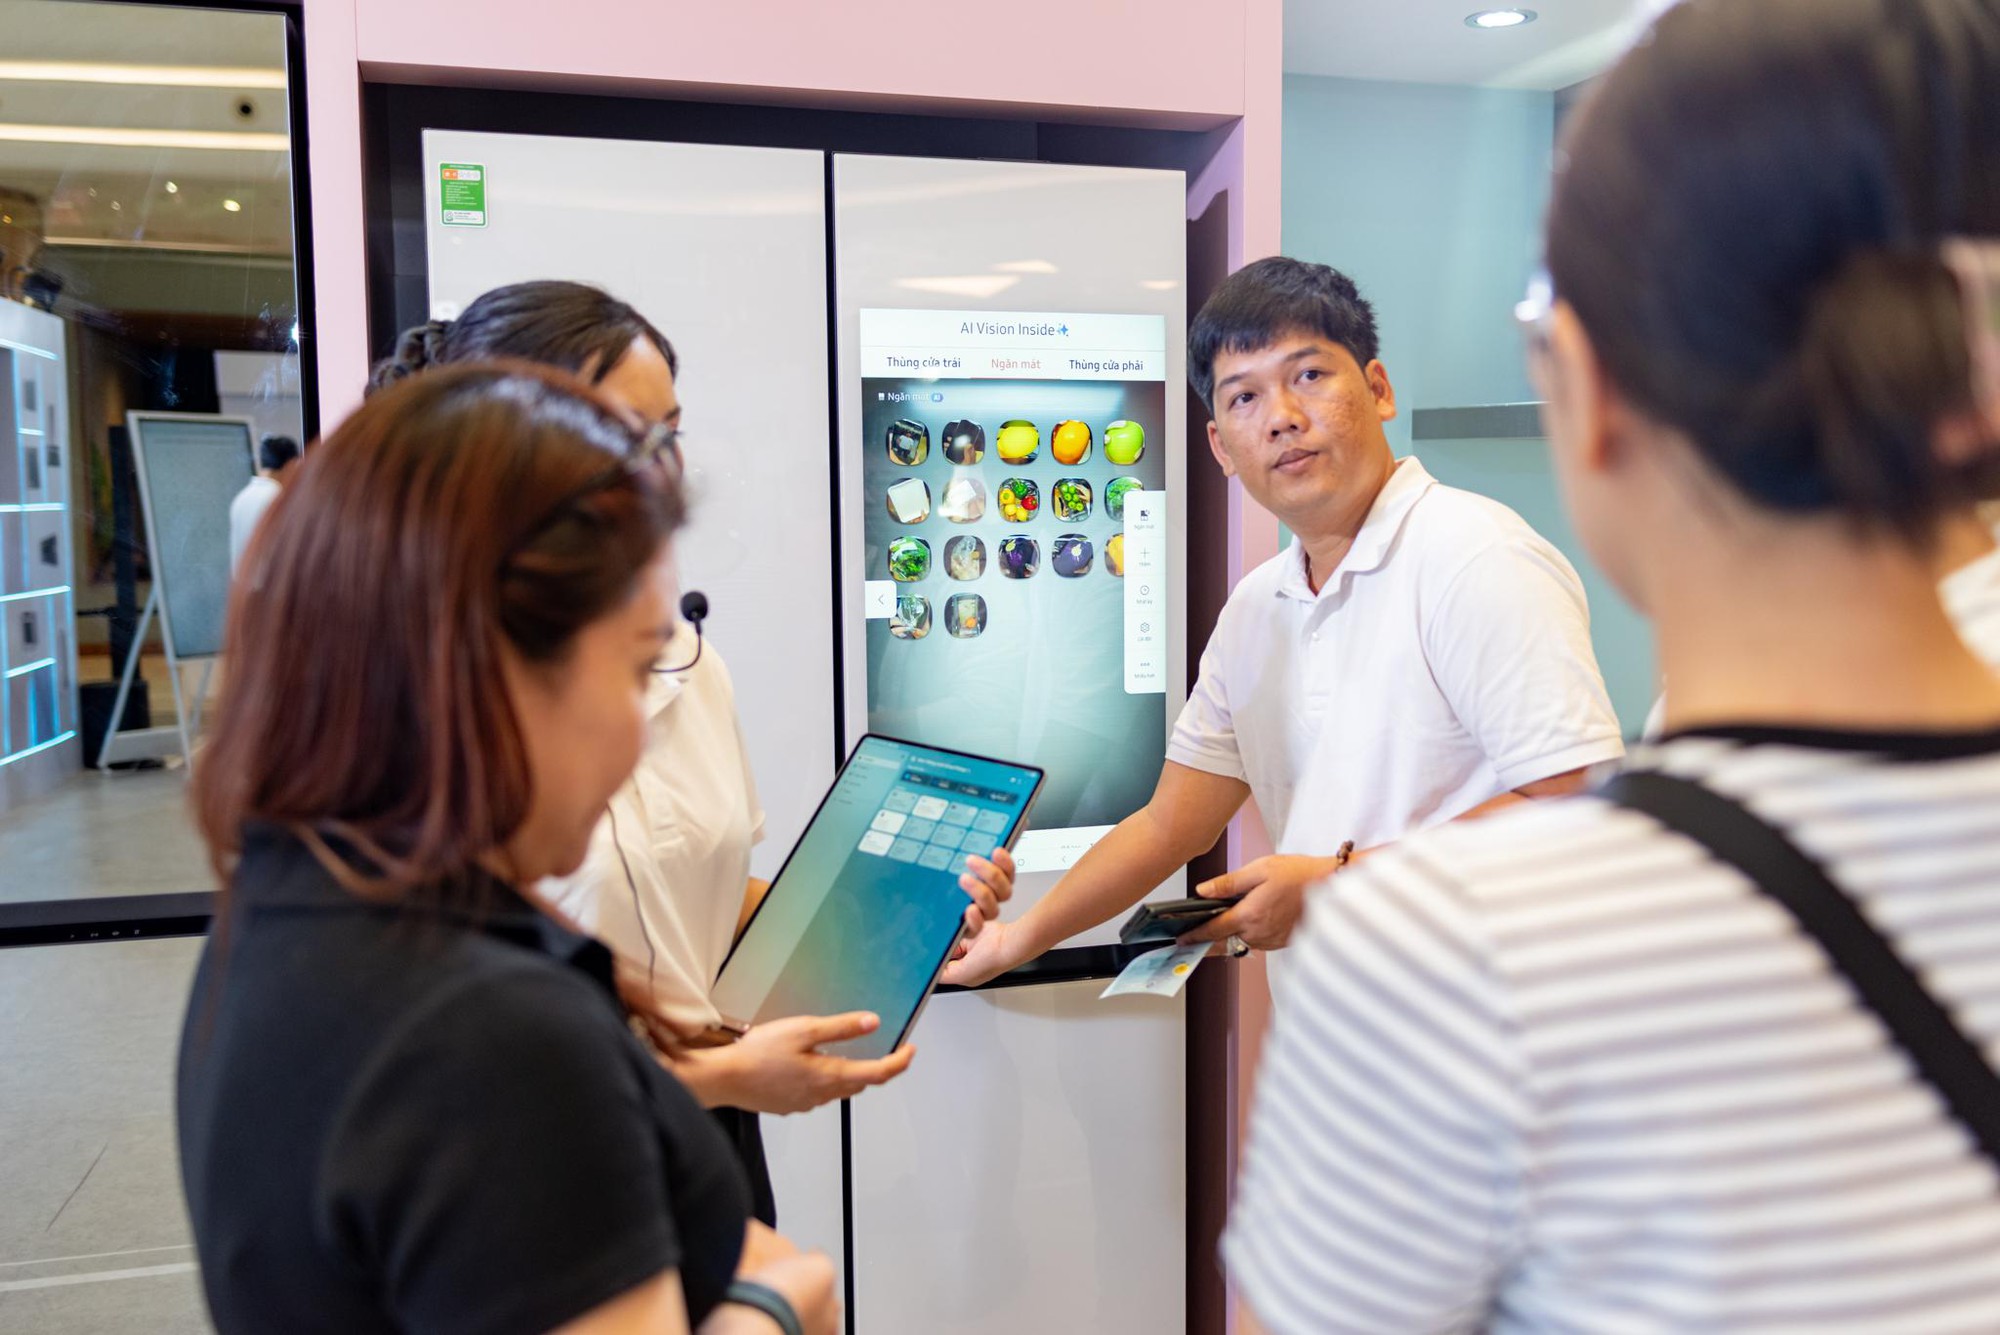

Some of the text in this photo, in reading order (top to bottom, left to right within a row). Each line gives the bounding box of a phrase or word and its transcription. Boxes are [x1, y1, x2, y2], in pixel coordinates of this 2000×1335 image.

[960, 322, 1055, 336] AI Vision Inside
[886, 356, 920, 370] Thùng
[943, 357, 961, 368] trái
[991, 358, 1041, 371] Ngăn mát
[1069, 359, 1144, 372] Thùng cửa phải
[887, 391, 911, 402] Ngăn
